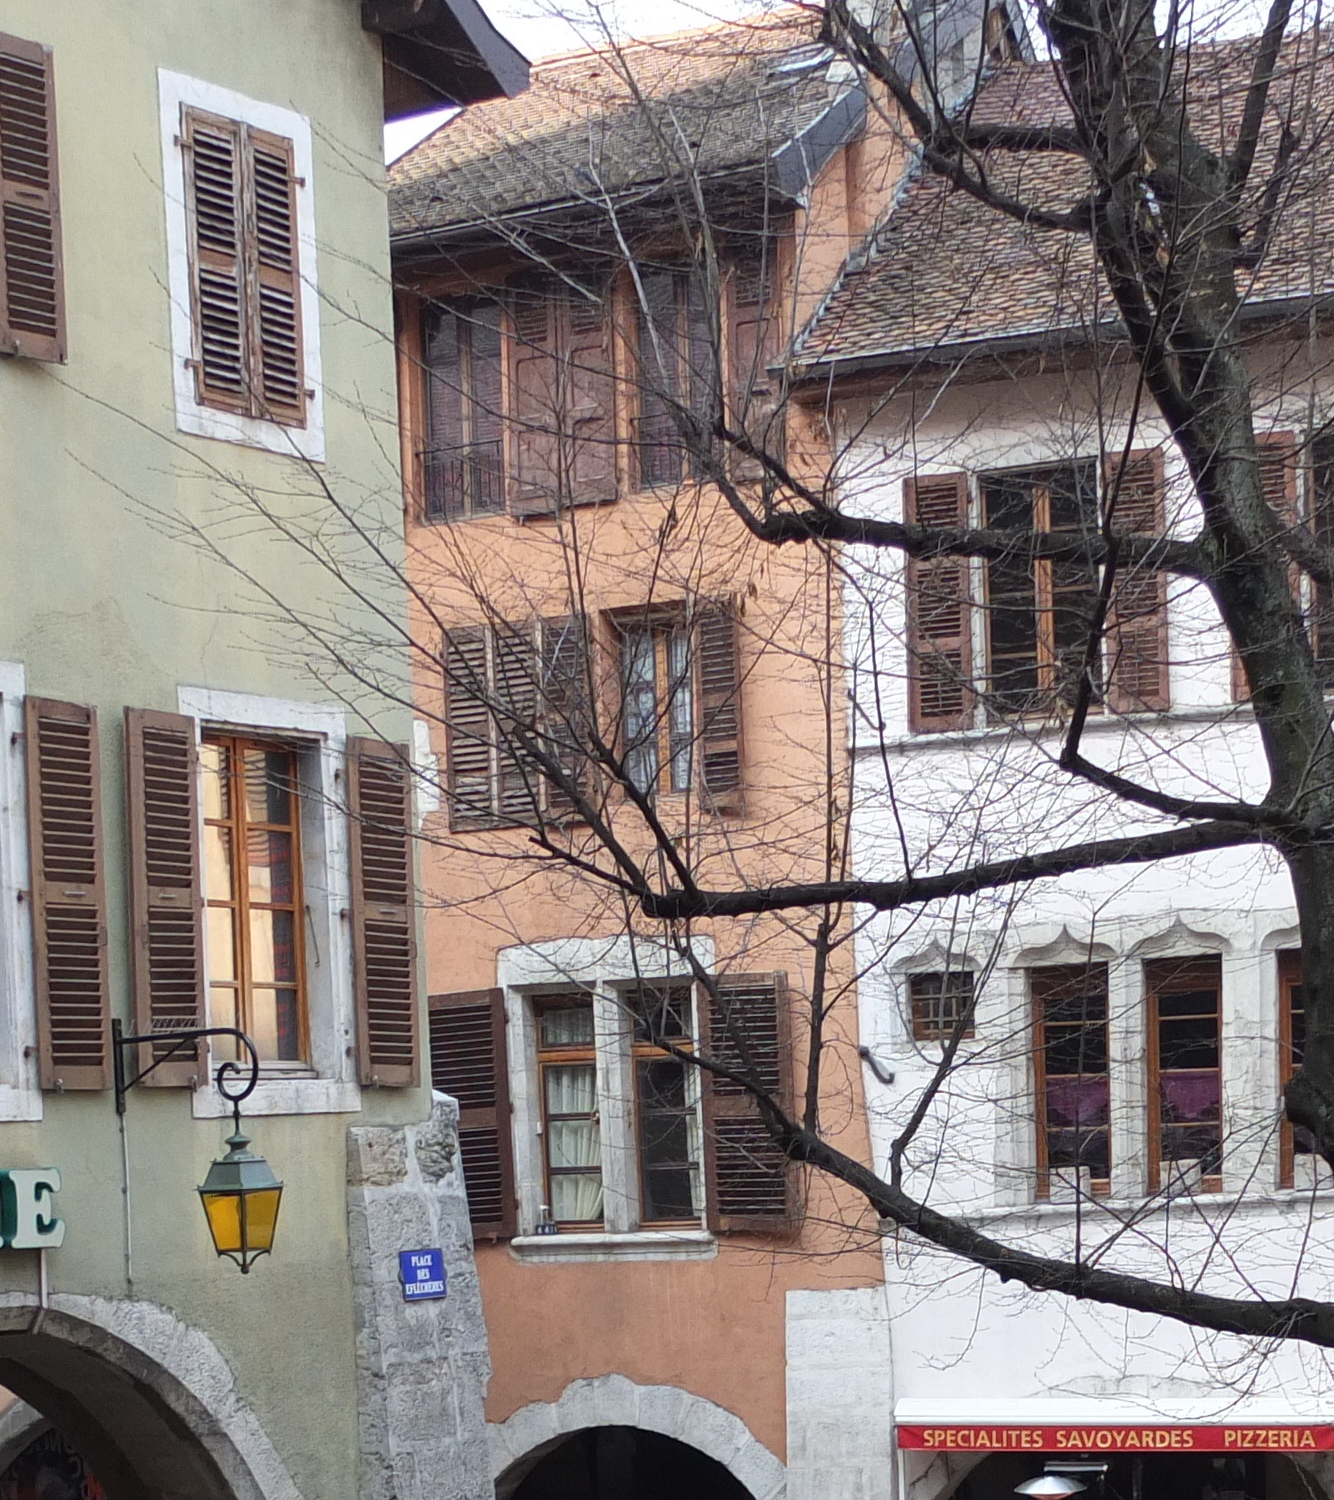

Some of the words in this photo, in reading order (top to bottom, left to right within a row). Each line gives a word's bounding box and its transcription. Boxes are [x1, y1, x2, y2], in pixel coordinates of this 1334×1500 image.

[411, 1254, 432, 1267] PLACE
[923, 1429, 1043, 1448] SPECIALITES
[1056, 1429, 1194, 1448] SAVOYARDES
[1224, 1429, 1316, 1448] PIZZERIA
